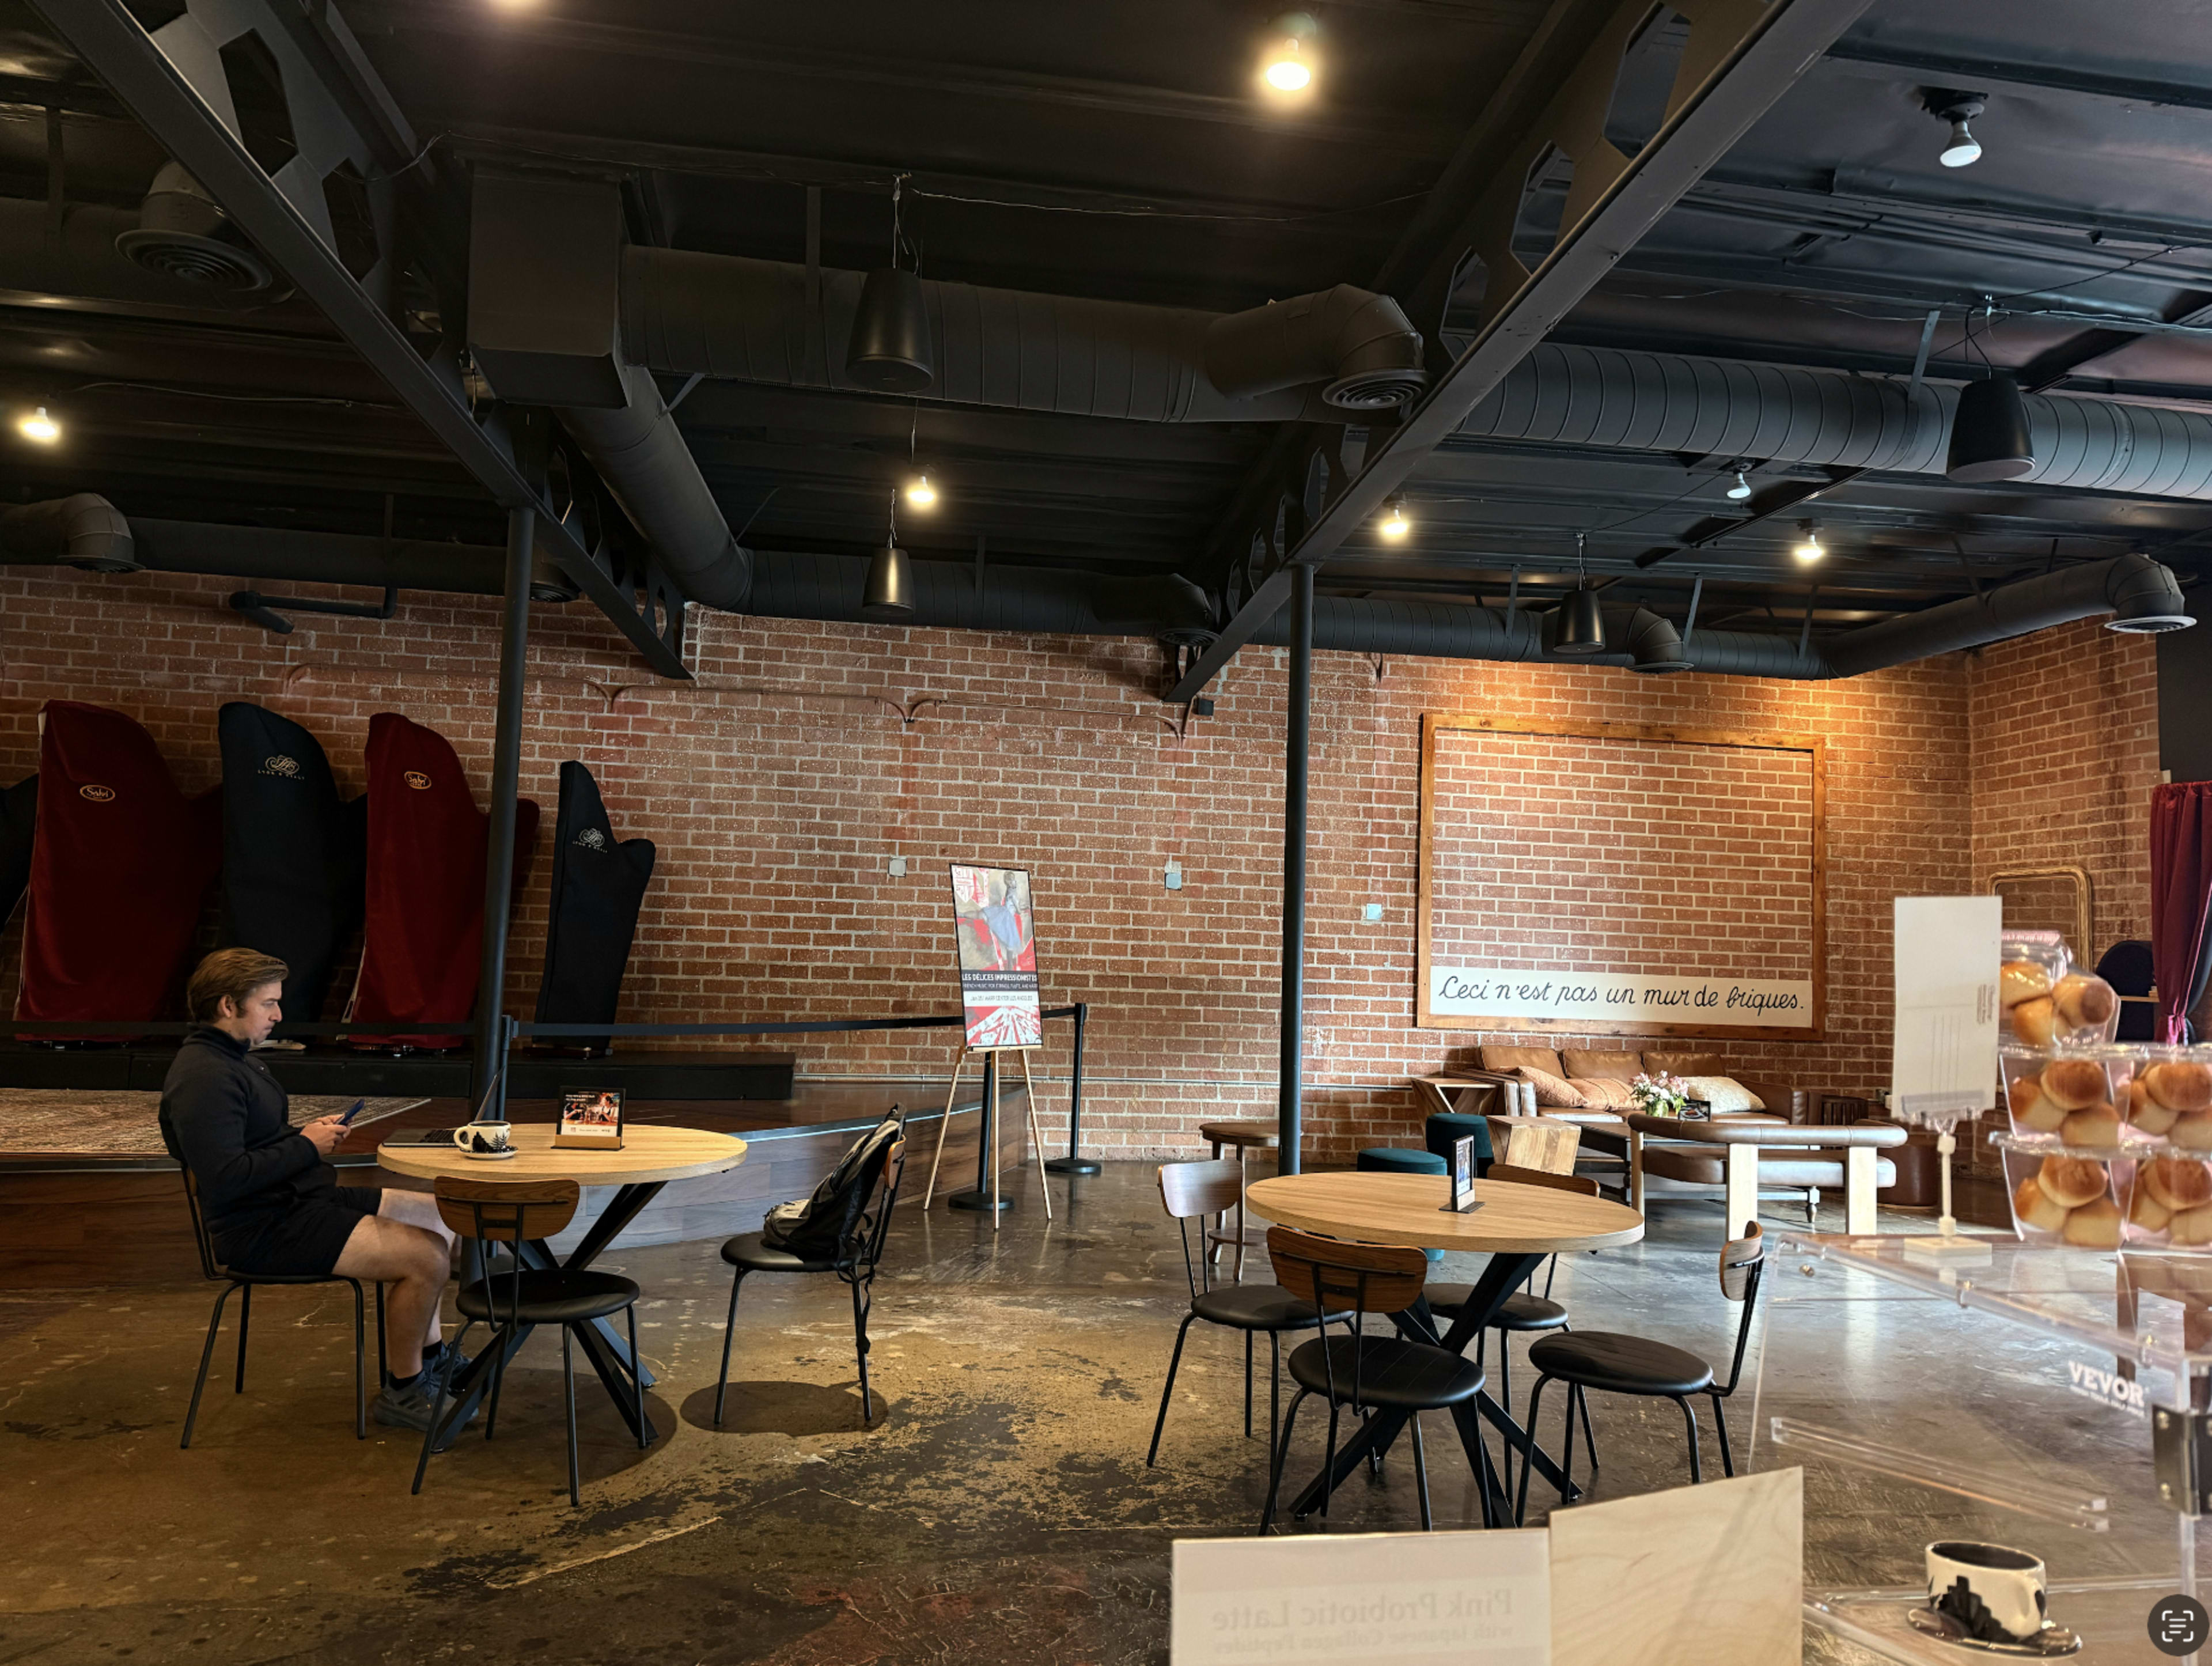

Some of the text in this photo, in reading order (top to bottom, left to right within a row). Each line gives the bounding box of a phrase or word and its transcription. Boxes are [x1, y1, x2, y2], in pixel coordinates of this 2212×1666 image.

[972, 972, 994, 981] DÉLICES
[1438, 975, 1804, 1017] Ceci n'est pas un mur de briques.
[2068, 1360, 2145, 1407] VEVOR
